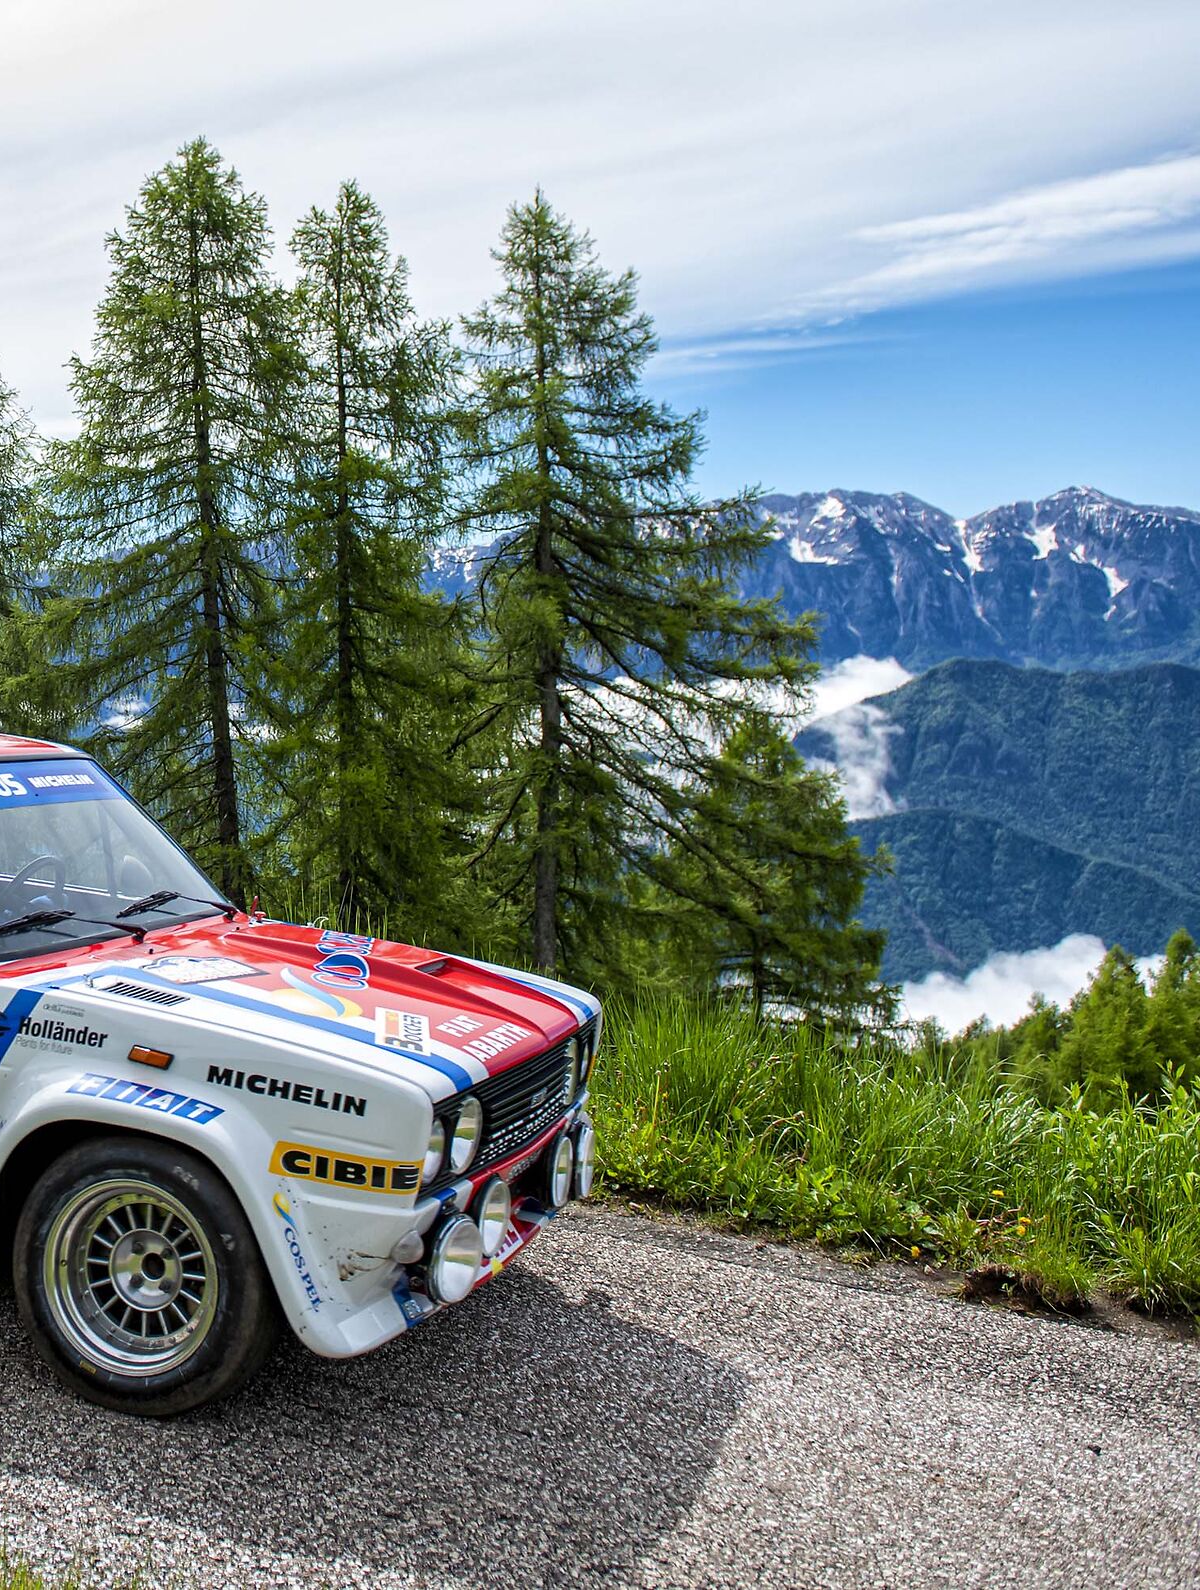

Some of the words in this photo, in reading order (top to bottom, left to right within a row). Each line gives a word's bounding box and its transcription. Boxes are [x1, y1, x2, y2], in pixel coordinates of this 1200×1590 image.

[27, 774, 94, 788] MICHELIN
[18, 1016, 108, 1048] Holländer
[435, 1014, 484, 1038] FIAT
[462, 1022, 532, 1062] ABARTH
[70, 1074, 221, 1123] FIAT
[206, 1064, 367, 1117] MICHELIN
